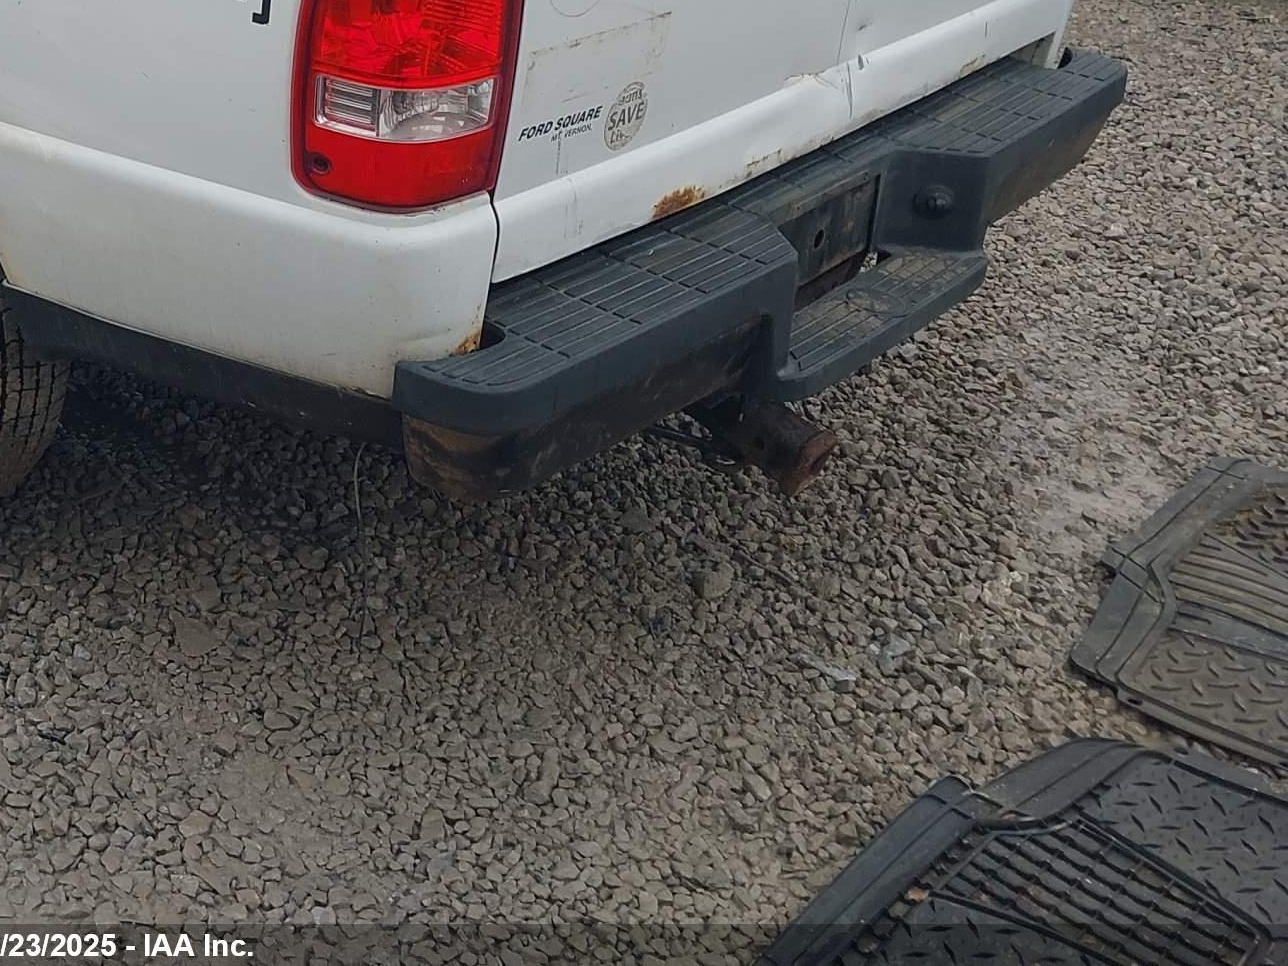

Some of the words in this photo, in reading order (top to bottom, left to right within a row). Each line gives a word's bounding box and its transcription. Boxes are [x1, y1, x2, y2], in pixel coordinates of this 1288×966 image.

[518, 121, 554, 142] FORD
[554, 105, 603, 131] SQUARE
[608, 102, 645, 131] SAVE
